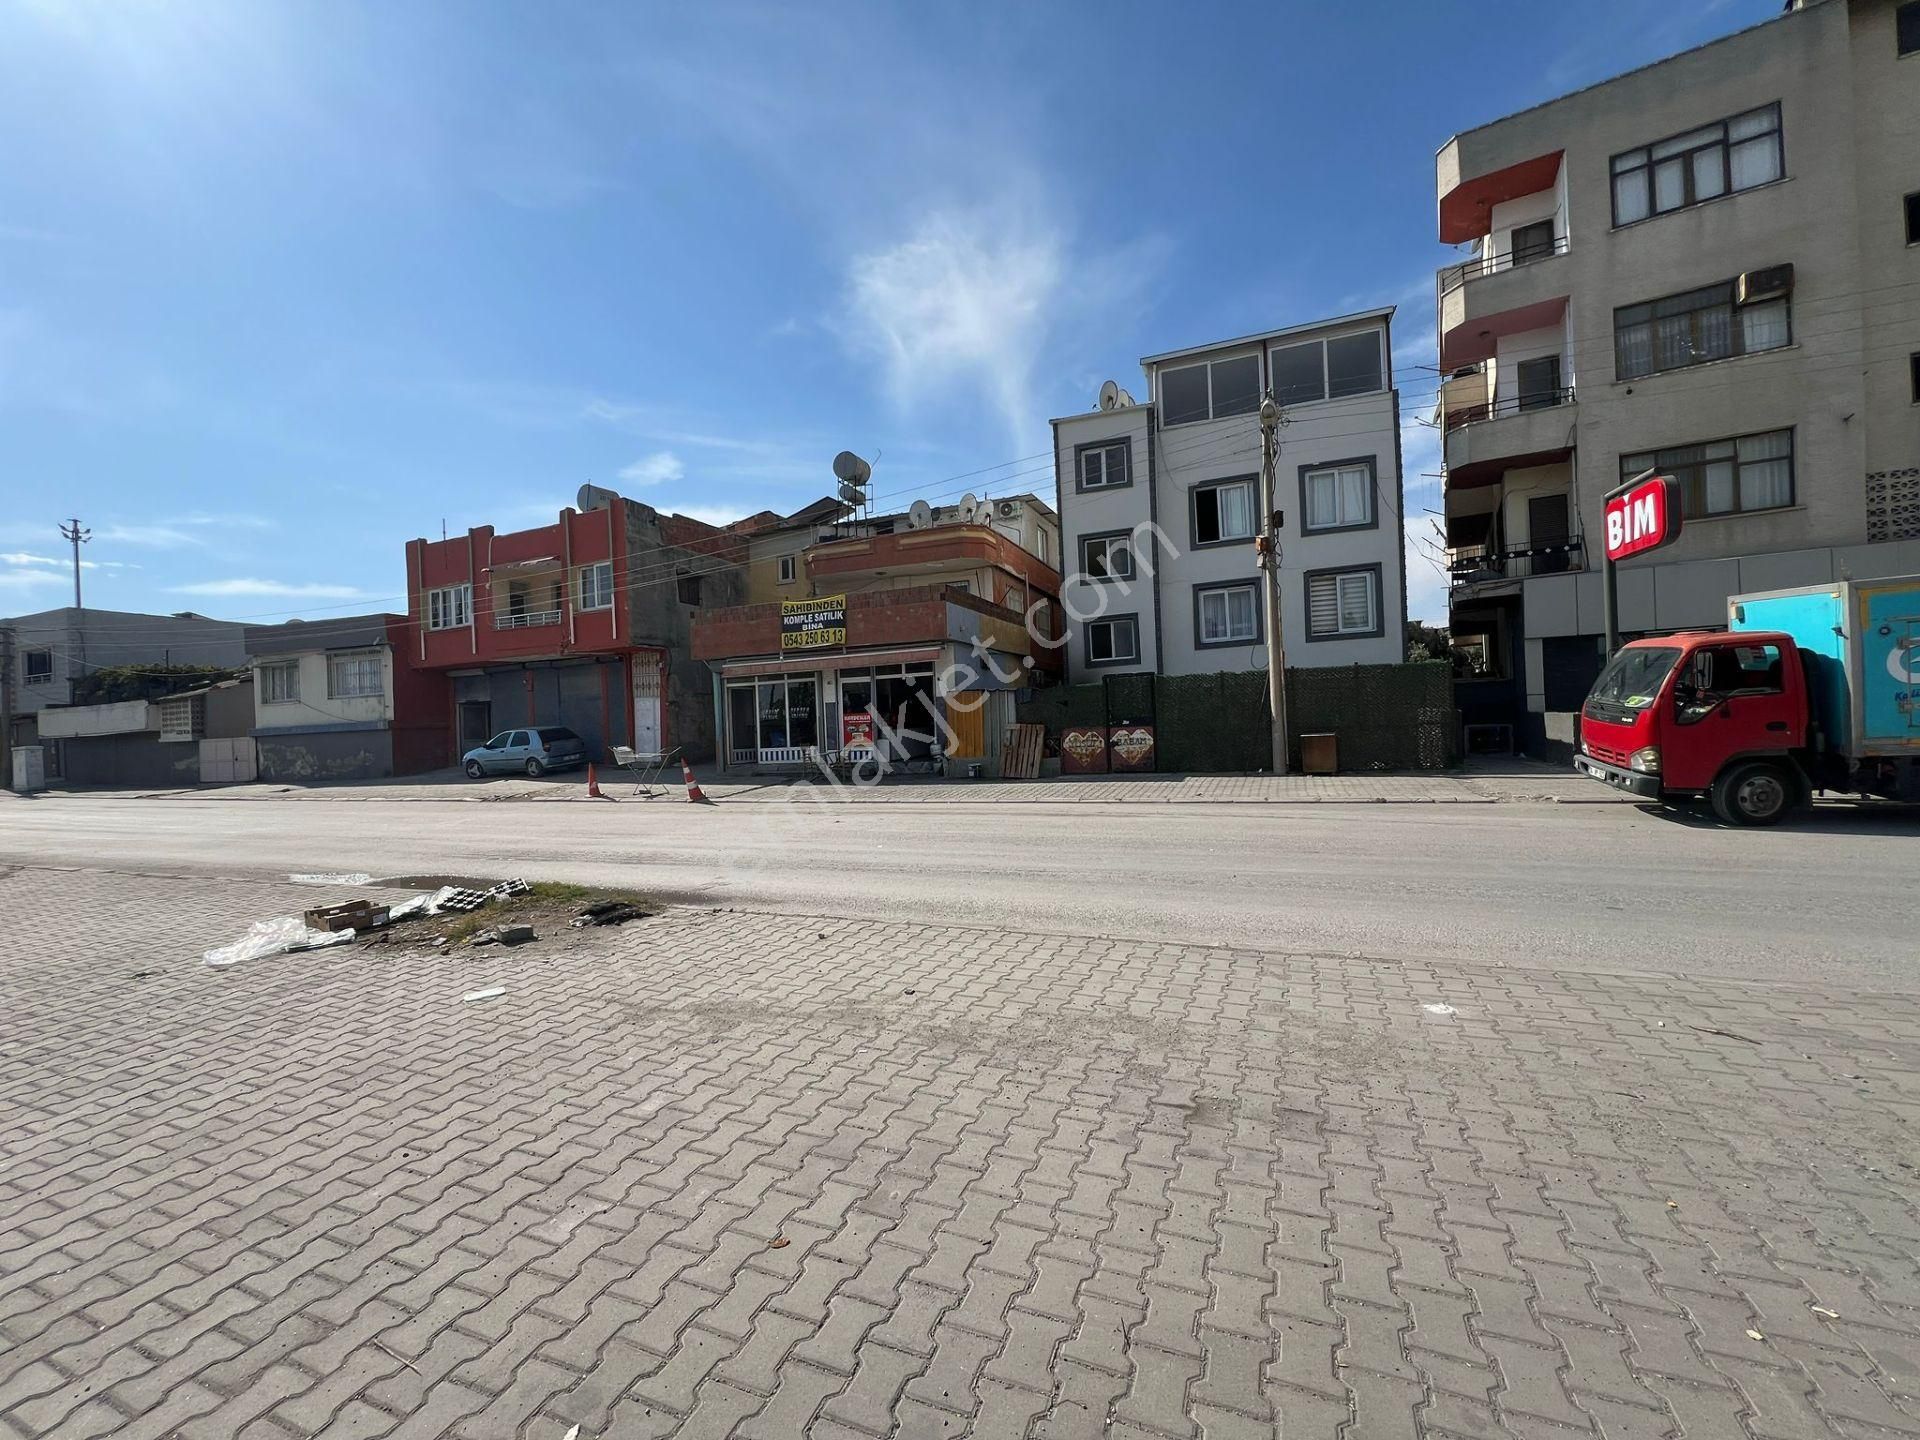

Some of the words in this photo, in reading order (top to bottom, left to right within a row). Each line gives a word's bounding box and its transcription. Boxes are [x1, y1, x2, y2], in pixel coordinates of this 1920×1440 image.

[784, 614, 813, 625] KOMPLE
[814, 610, 843, 621] SATILIK
[784, 633, 803, 647] 0543
[804, 631, 819, 645] 250
[820, 630, 830, 643] 63
[831, 629, 843, 642] 13
